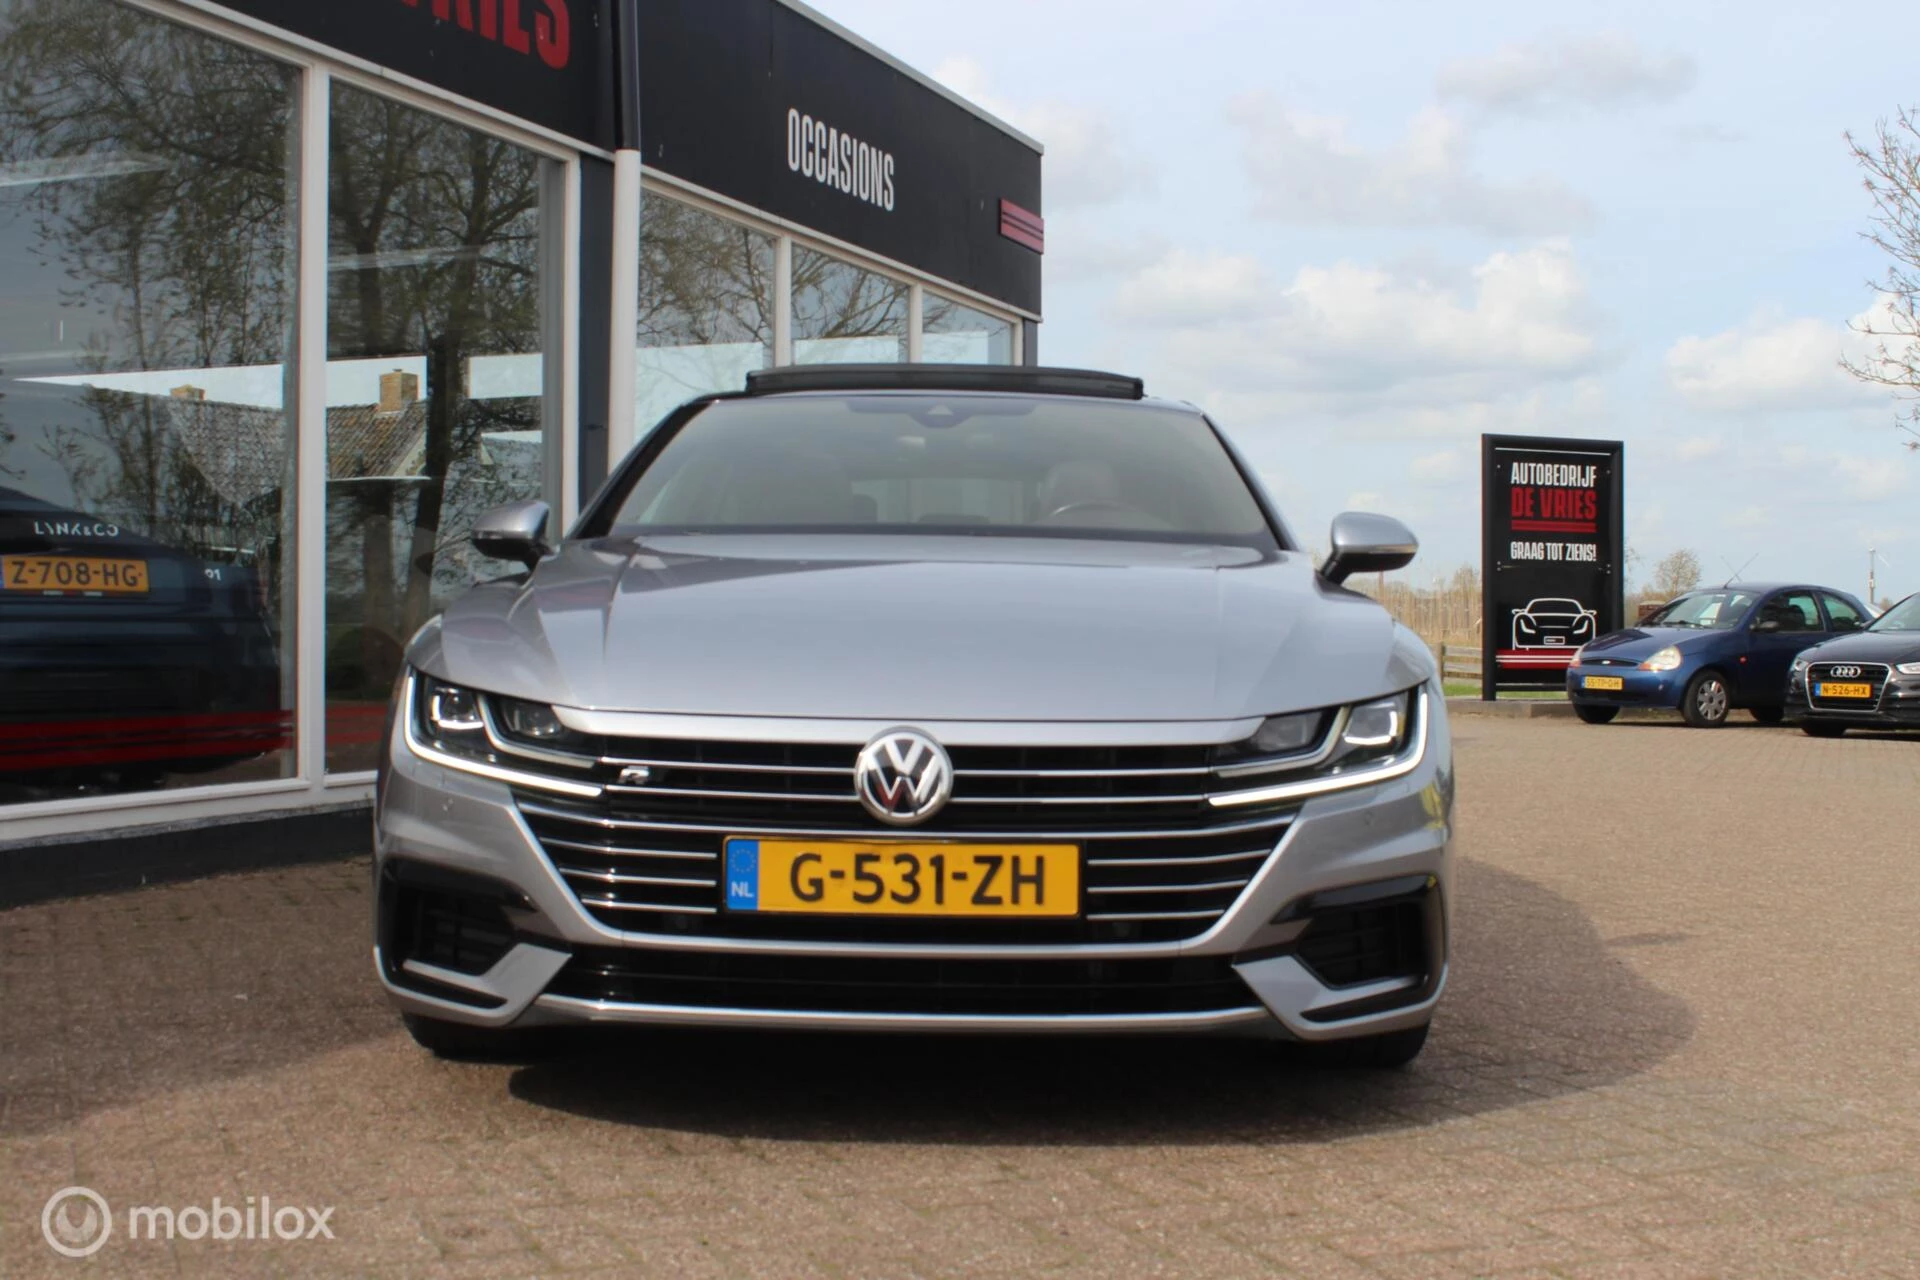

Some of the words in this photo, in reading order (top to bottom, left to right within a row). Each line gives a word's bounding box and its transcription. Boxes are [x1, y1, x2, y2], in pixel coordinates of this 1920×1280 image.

[787, 107, 894, 212] OCCASIONS
[1510, 462, 1597, 488] AUTOBEDRIJF
[1511, 487, 1535, 517] DE
[1539, 488, 1597, 520] VRIES
[1510, 541, 1545, 560] GRAAG
[1546, 542, 1564, 561] TOT
[1565, 543, 1597, 562] ZIENS!
[11, 560, 139, 588] Z-708-HG
[731, 881, 753, 897] NL
[789, 852, 1045, 906] G-531-ZH
